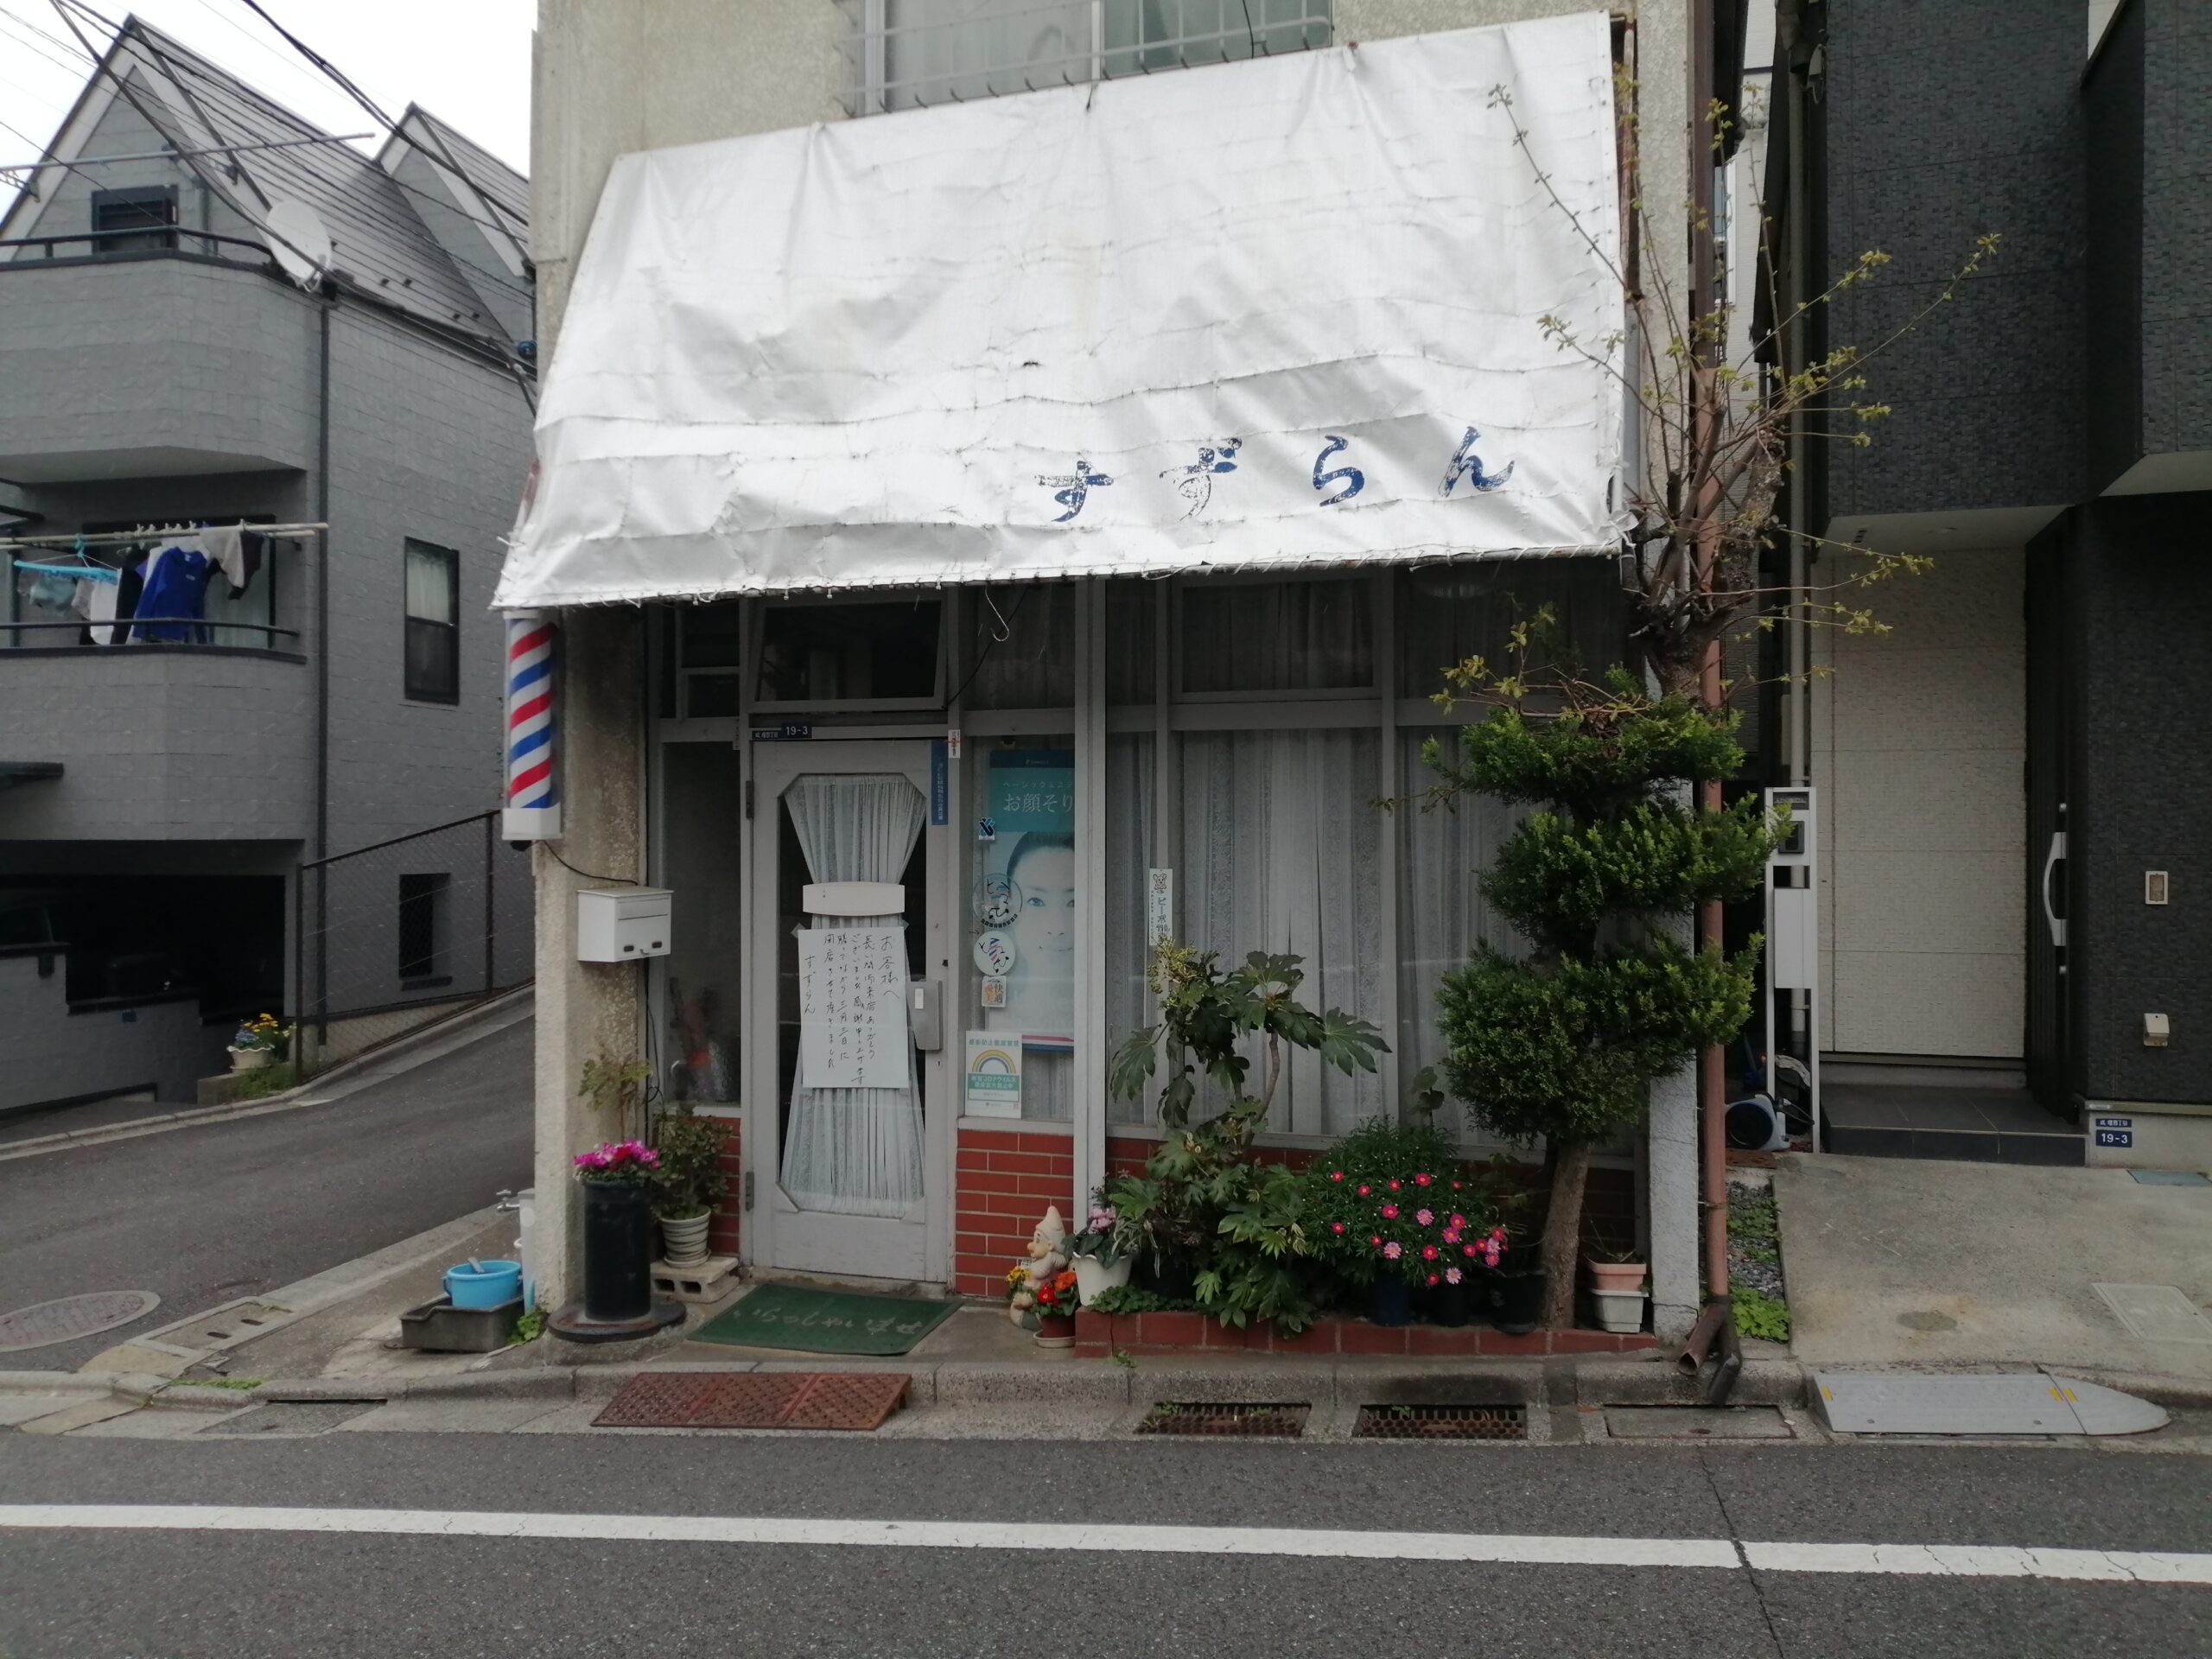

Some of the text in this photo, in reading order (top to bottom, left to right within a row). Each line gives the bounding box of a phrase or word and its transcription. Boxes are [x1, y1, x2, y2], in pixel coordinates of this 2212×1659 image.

[1034, 426, 1516, 522] すずらん
[785, 726, 808, 735] 19-3
[1003, 793, 1073, 813] お顔そり
[803, 955, 816, 1014] すずらん
[878, 935, 899, 1000] お客様へ
[2101, 1134, 2128, 1143] 19-3
